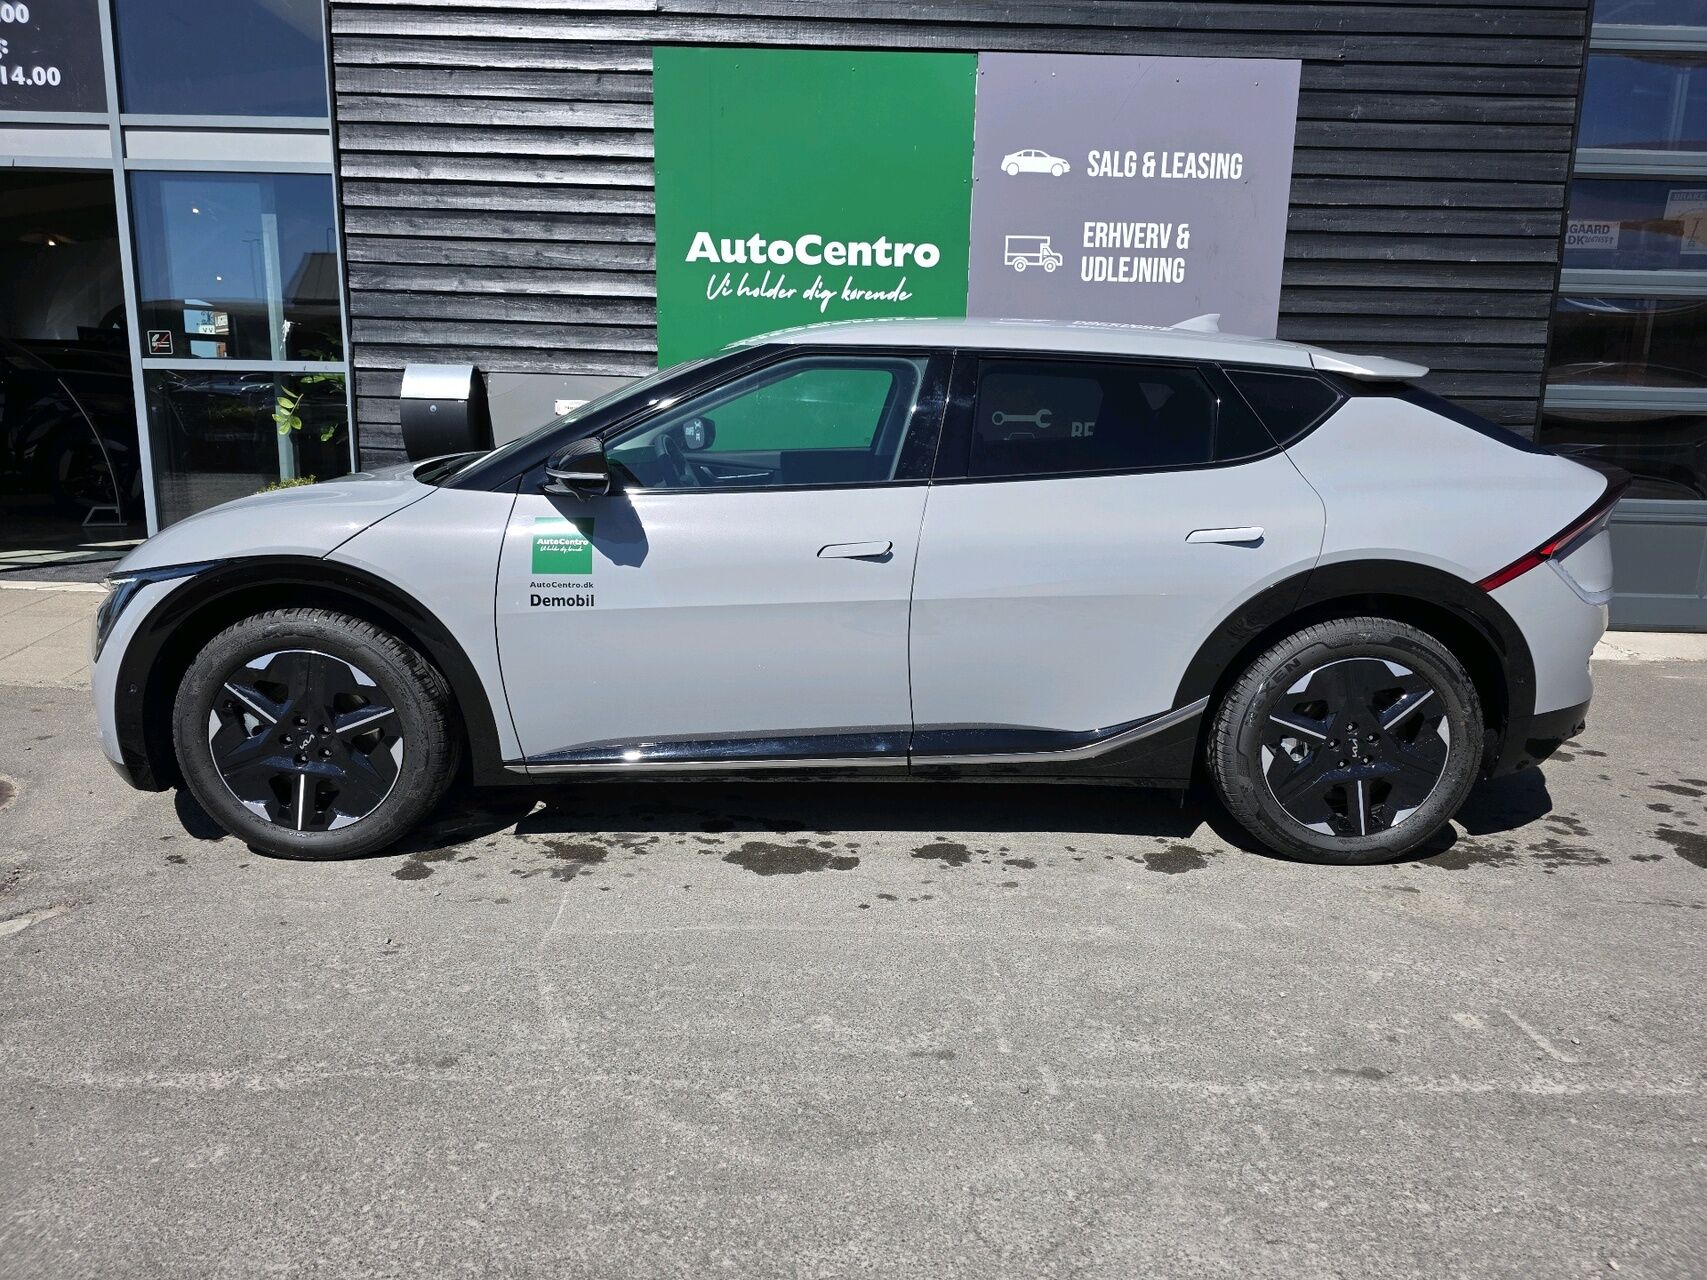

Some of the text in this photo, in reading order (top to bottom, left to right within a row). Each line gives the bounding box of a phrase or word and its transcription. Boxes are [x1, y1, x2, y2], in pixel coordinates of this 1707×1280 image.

[0, 3, 29, 23] 00
[1087, 150, 1243, 179] SALG & LEASING
[1083, 221, 1190, 249] ERHVERV &
[685, 231, 940, 268] AutoCentro
[1081, 256, 1185, 283] UDLEJNING
[706, 272, 732, 300] Vi
[736, 270, 797, 300] holder
[802, 275, 837, 313] dig
[536, 538, 589, 546] AutoCentro
[530, 581, 594, 589] AutoCentro.dk
[530, 594, 595, 607] Demobil
